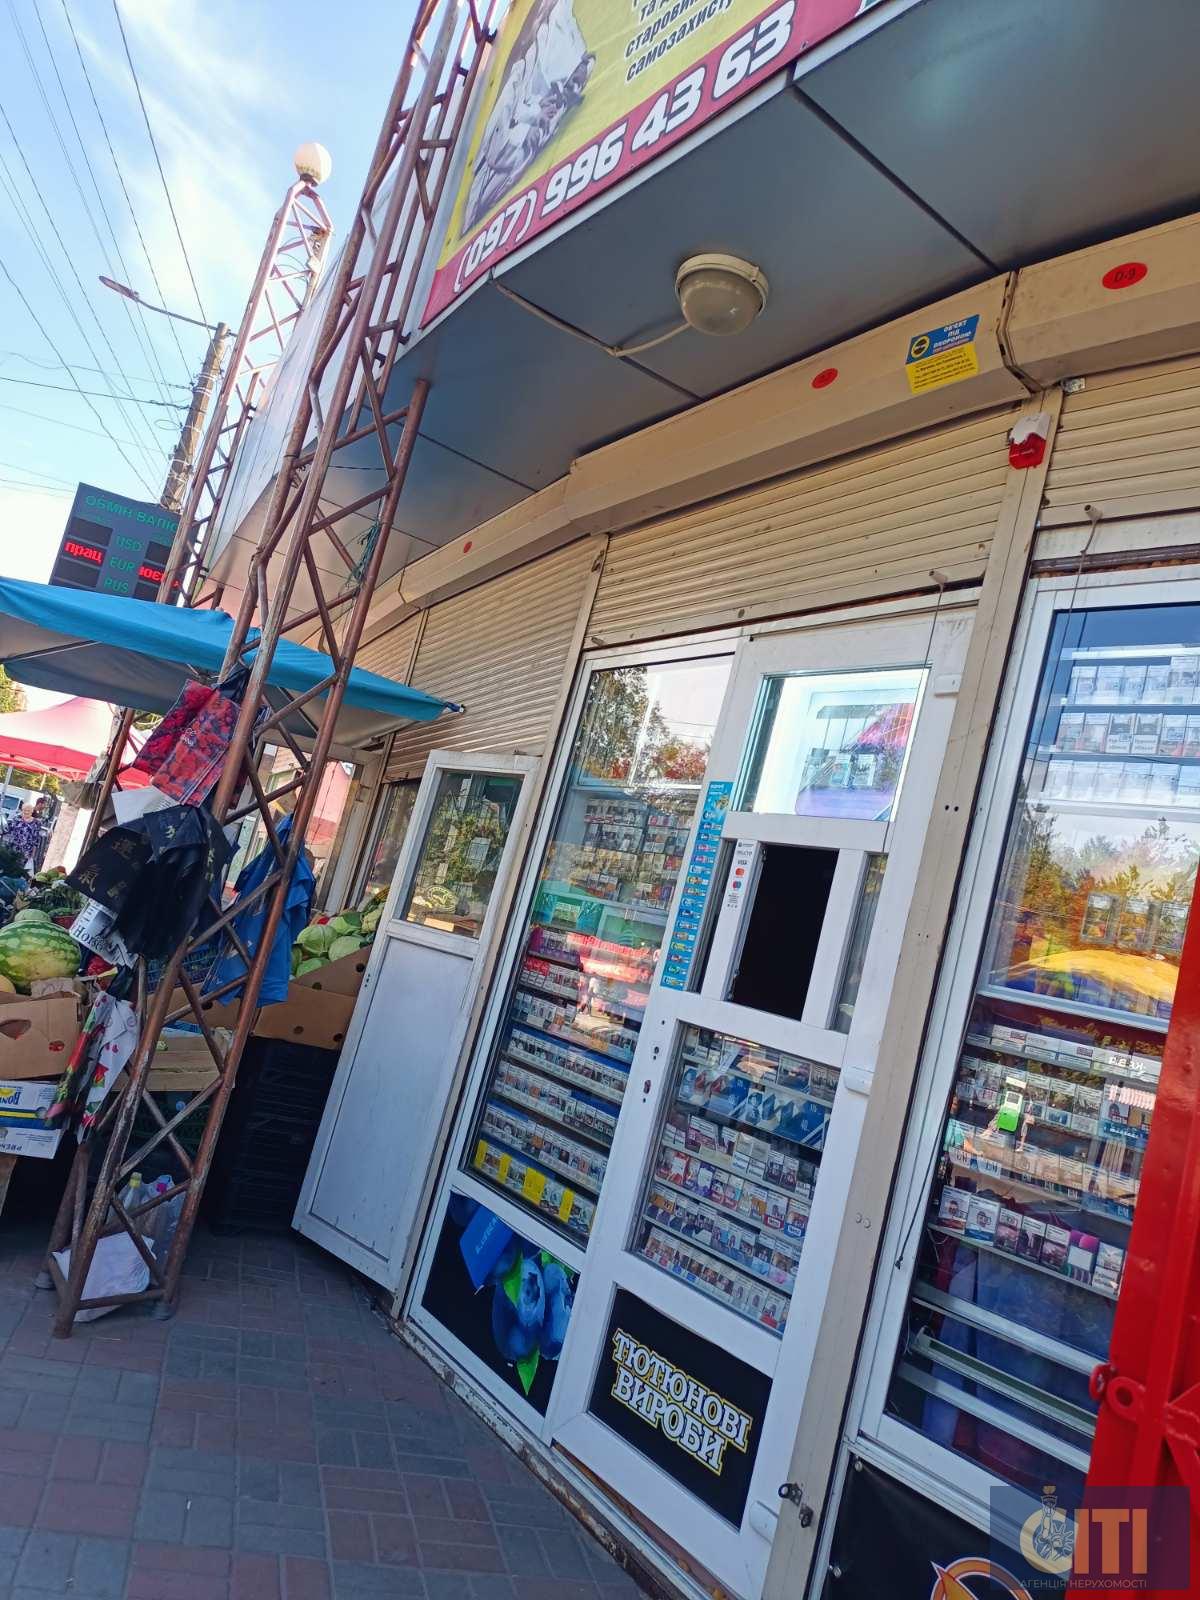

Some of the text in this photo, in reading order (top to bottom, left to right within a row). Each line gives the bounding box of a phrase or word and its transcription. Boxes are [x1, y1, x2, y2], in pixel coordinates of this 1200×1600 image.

[453, 0, 796, 294] (097) 996 43 63
[86, 495, 133, 518] ОБМІН
[115, 536, 144, 552] USD
[109, 556, 136, 572] EUR
[104, 577, 130, 594] RUS
[612, 1328, 753, 1453] ТЮТЮНОВІ
[611, 1364, 727, 1476] ВИРОБИ
